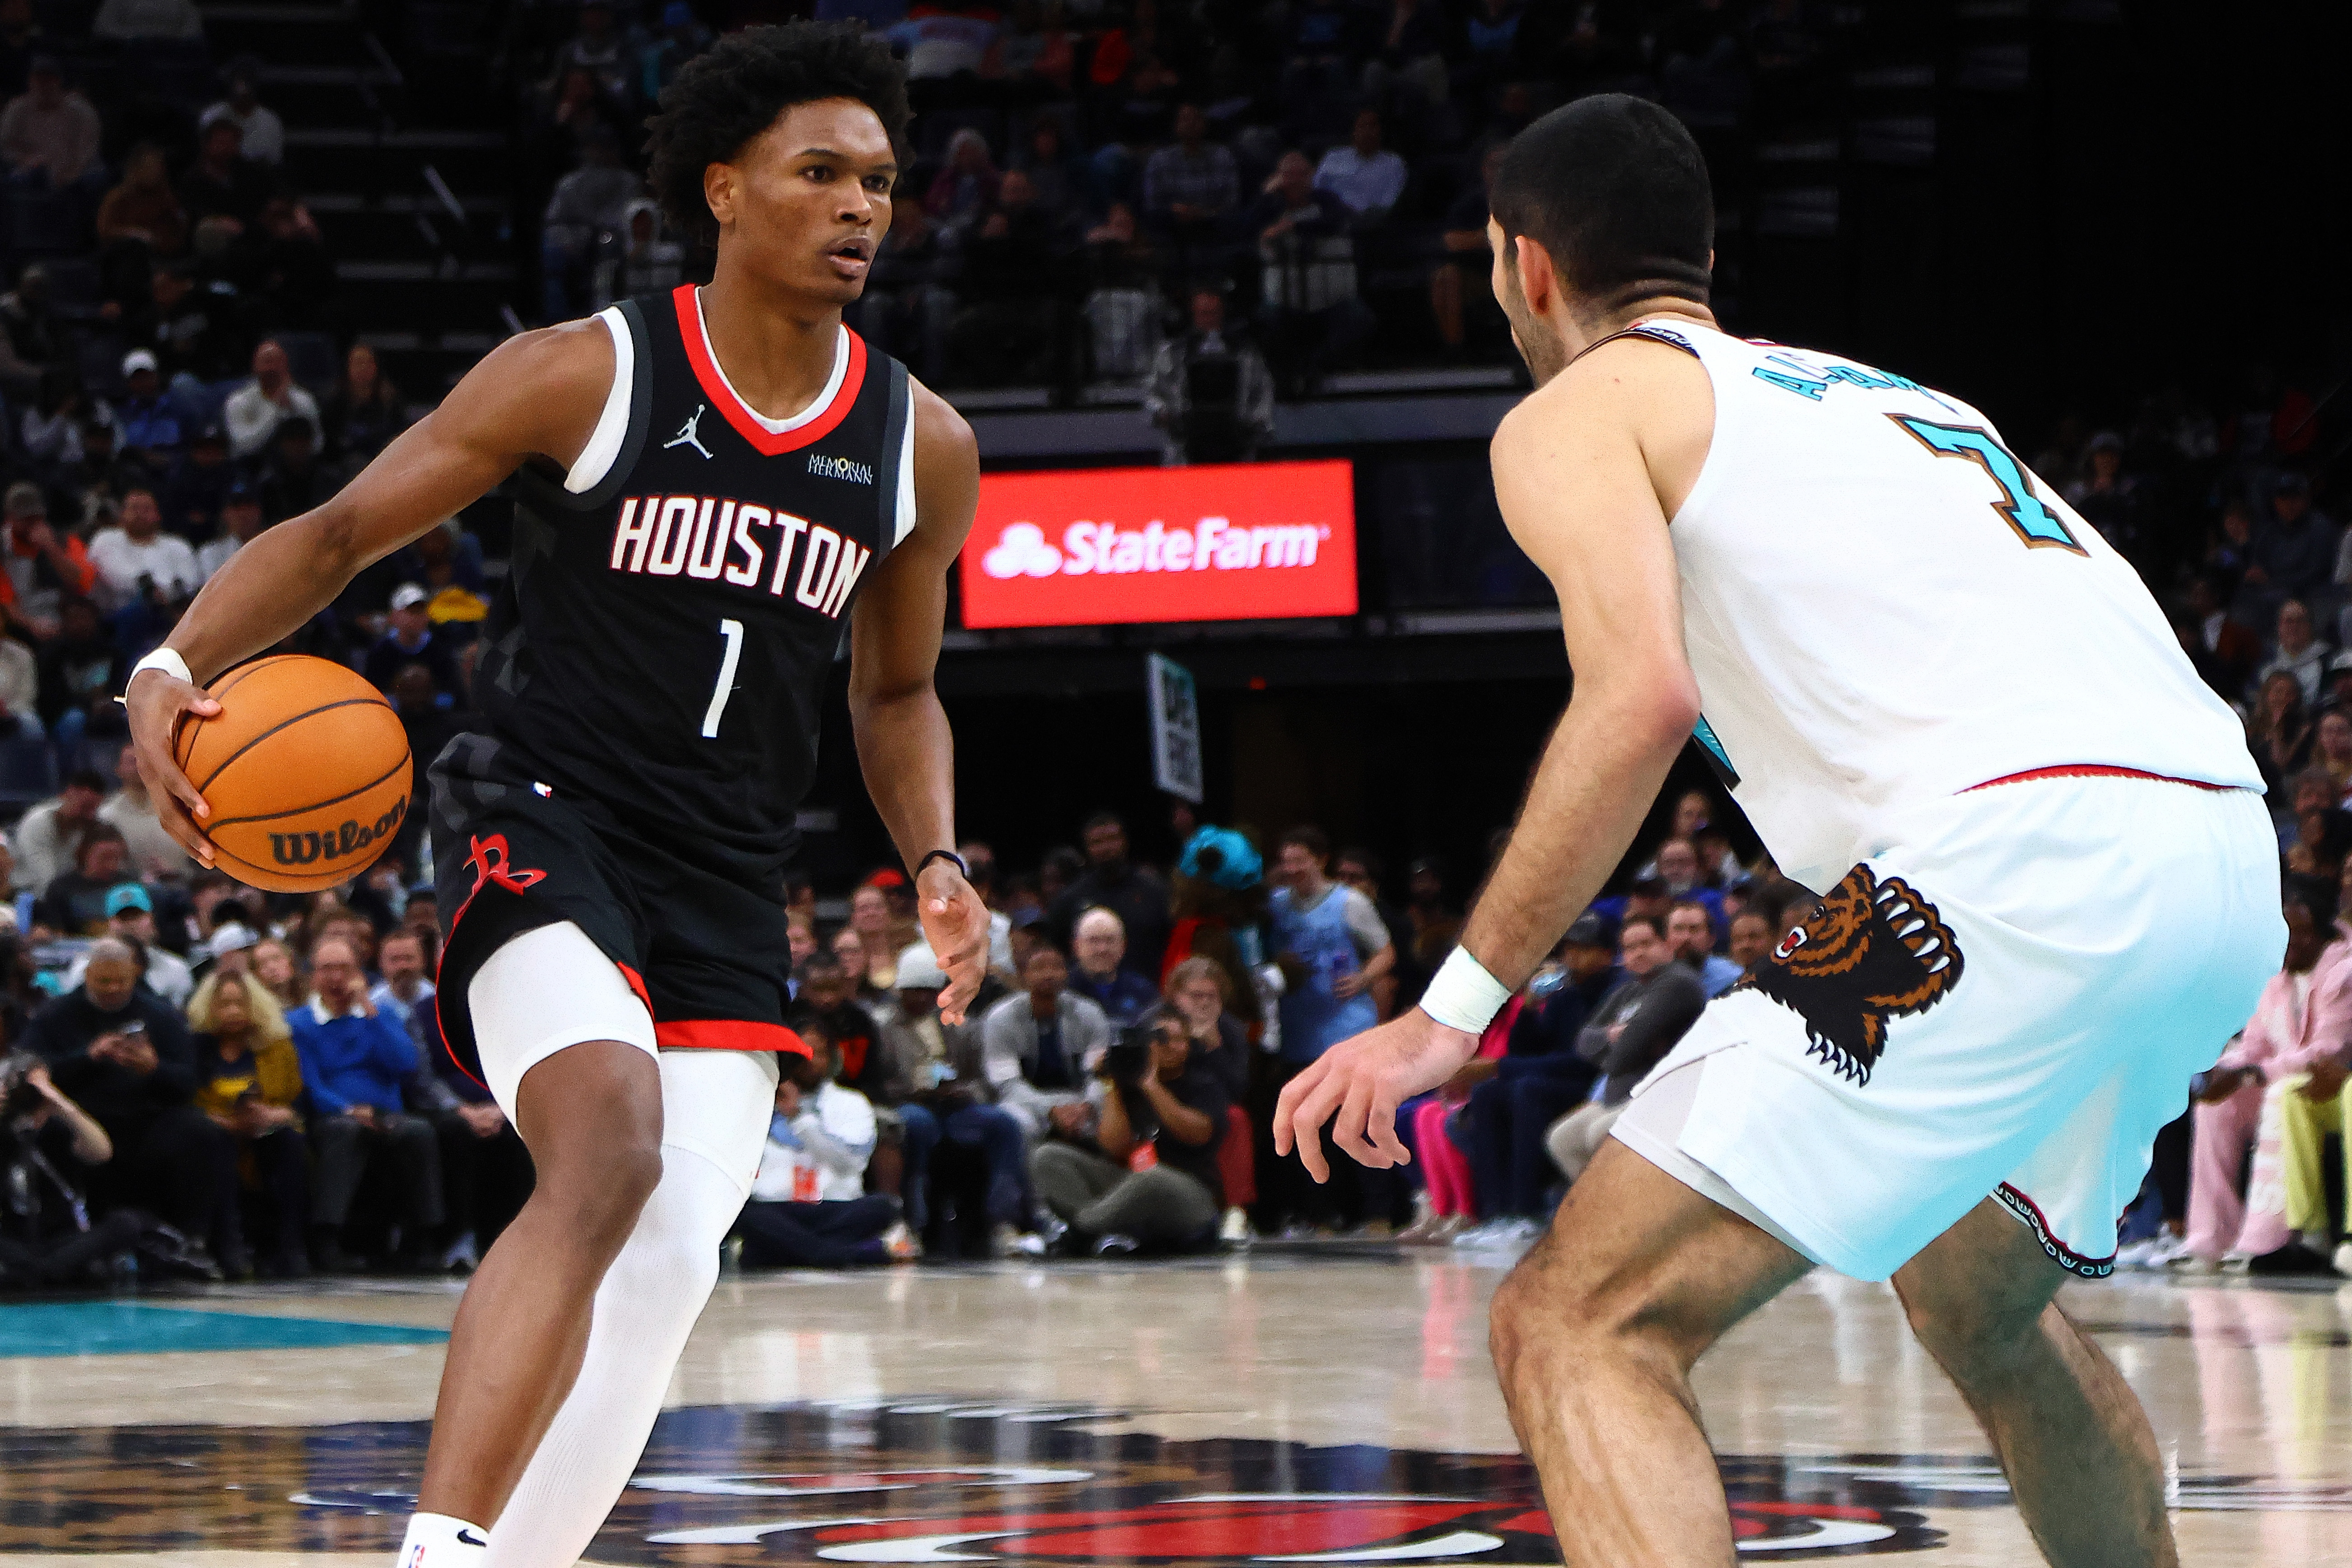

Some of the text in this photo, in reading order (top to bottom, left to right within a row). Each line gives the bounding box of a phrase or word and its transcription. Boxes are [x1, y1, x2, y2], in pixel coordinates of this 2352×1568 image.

[808, 462, 872, 485] HERMANN
[810, 453, 873, 477] MEMORIAL
[1882, 412, 2091, 557] 7
[609, 495, 873, 620] HOUSTON
[702, 618, 744, 737] 1
[267, 795, 406, 865] Wilson
